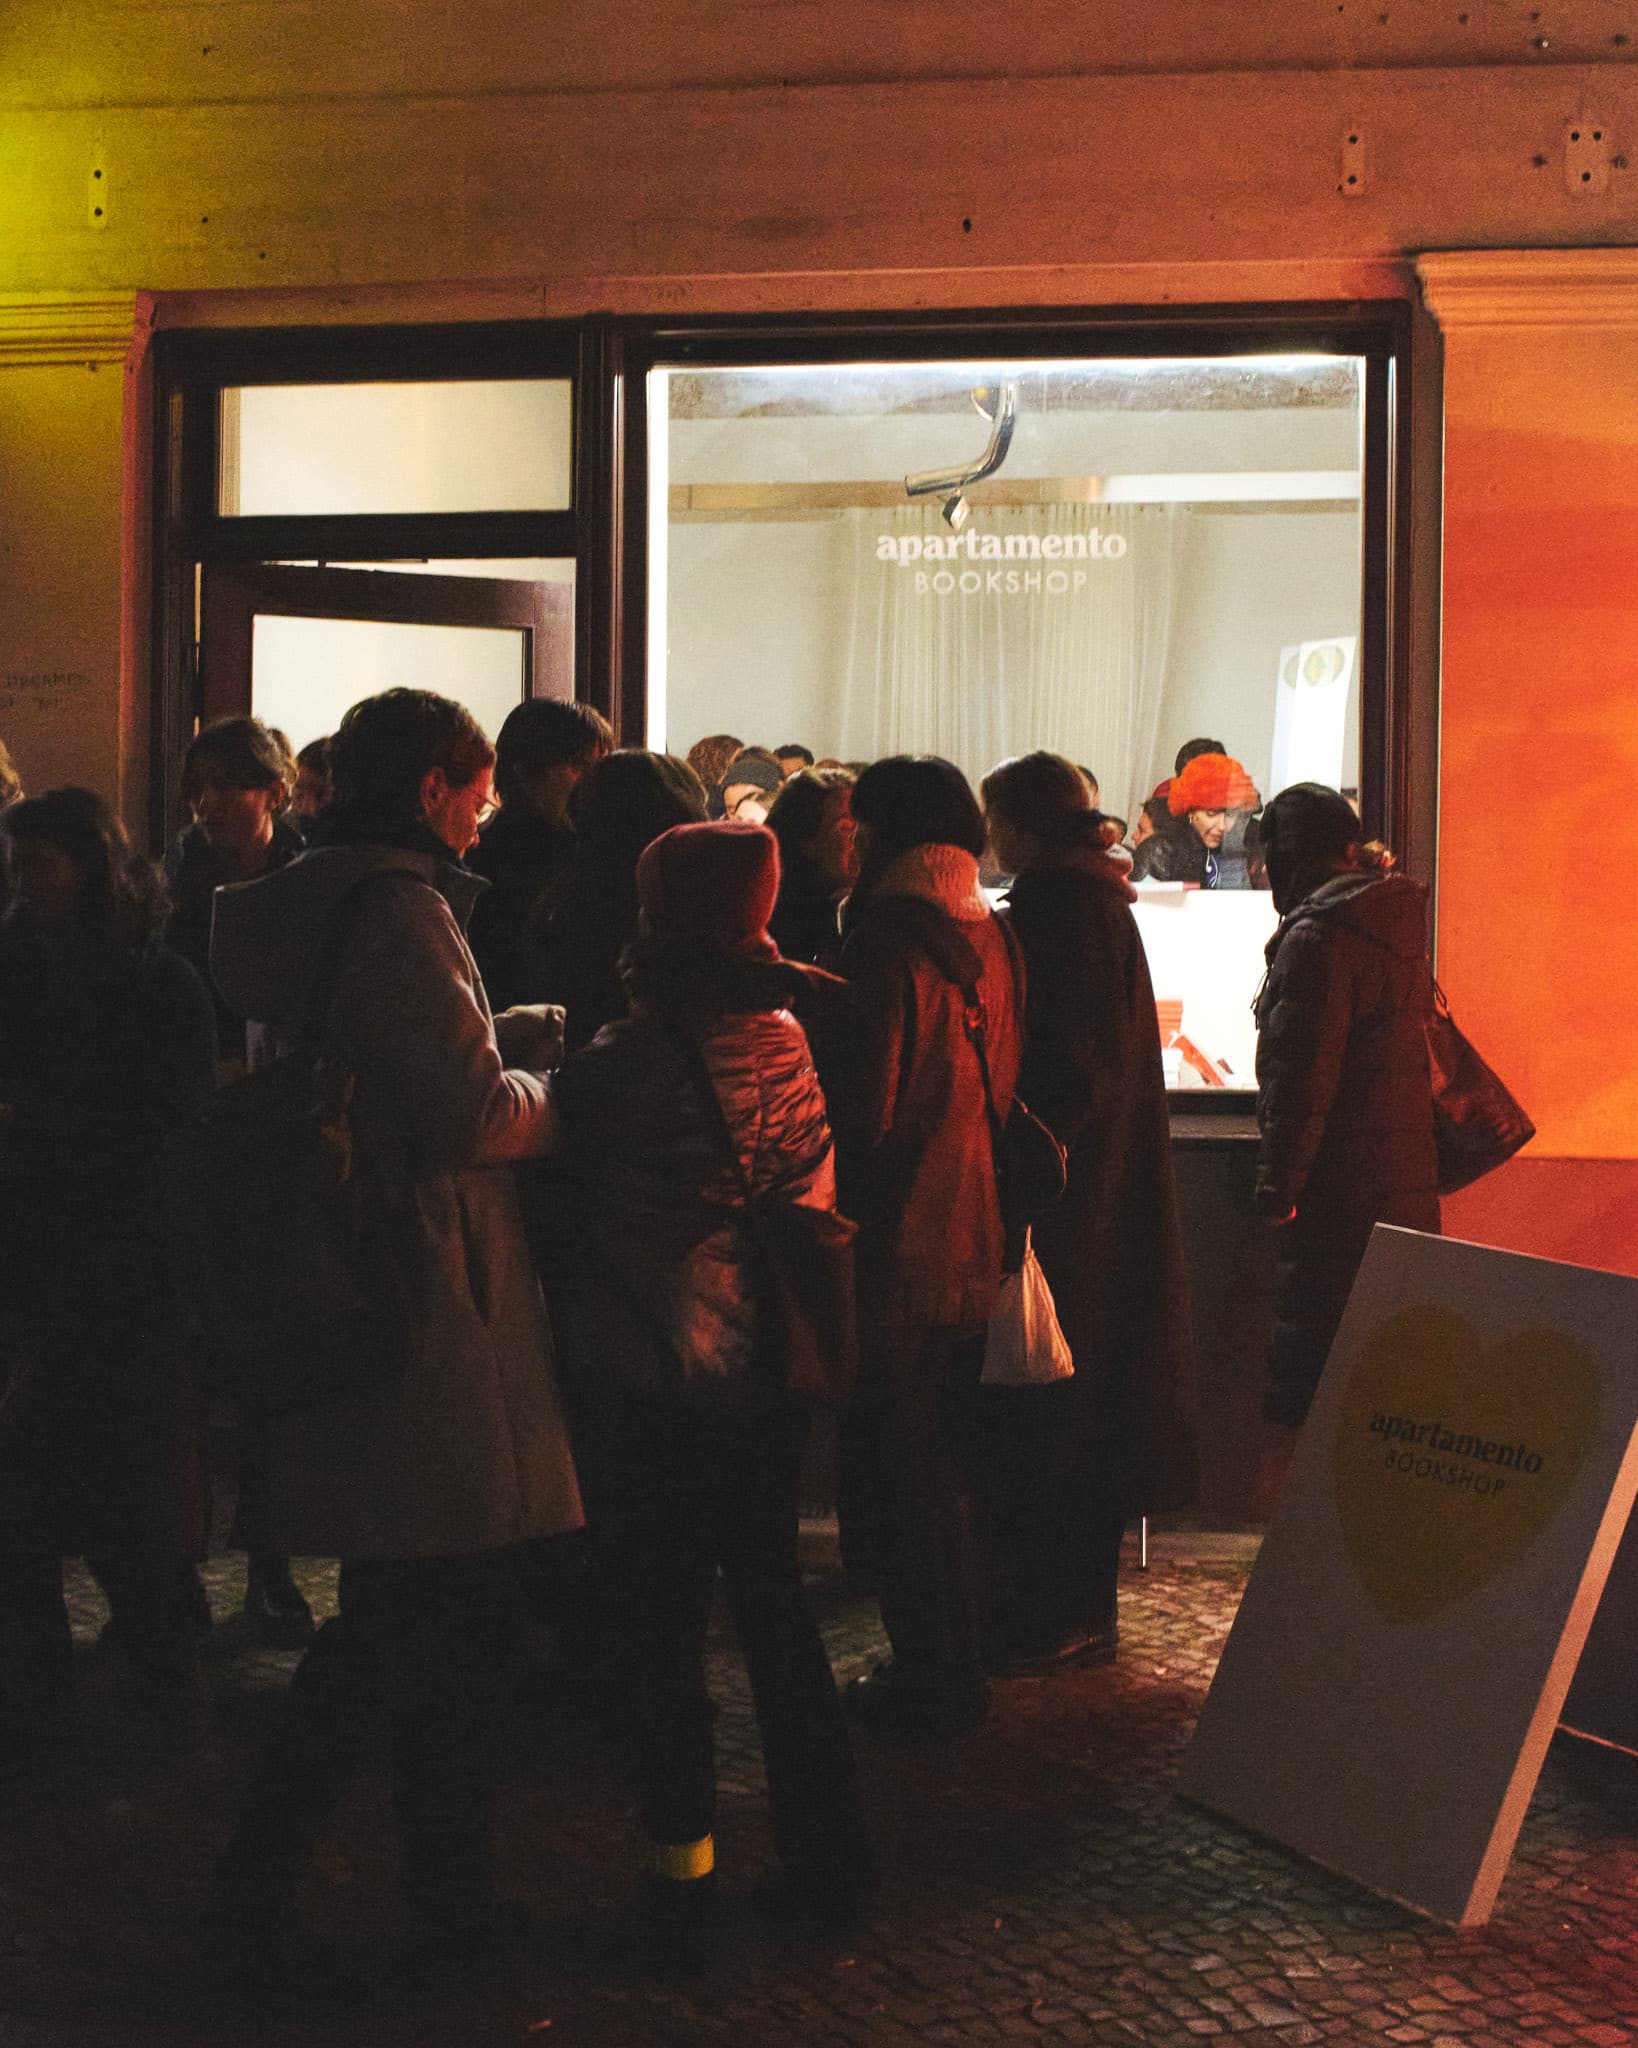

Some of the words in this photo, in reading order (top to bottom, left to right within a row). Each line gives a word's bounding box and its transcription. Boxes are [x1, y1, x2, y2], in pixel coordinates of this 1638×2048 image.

[876, 528, 1127, 567] apartamento
[915, 571, 1087, 594] BOOKSHOP
[1370, 1412, 1543, 1473] apartamento
[1384, 1451, 1506, 1496] BOOKSHOP
